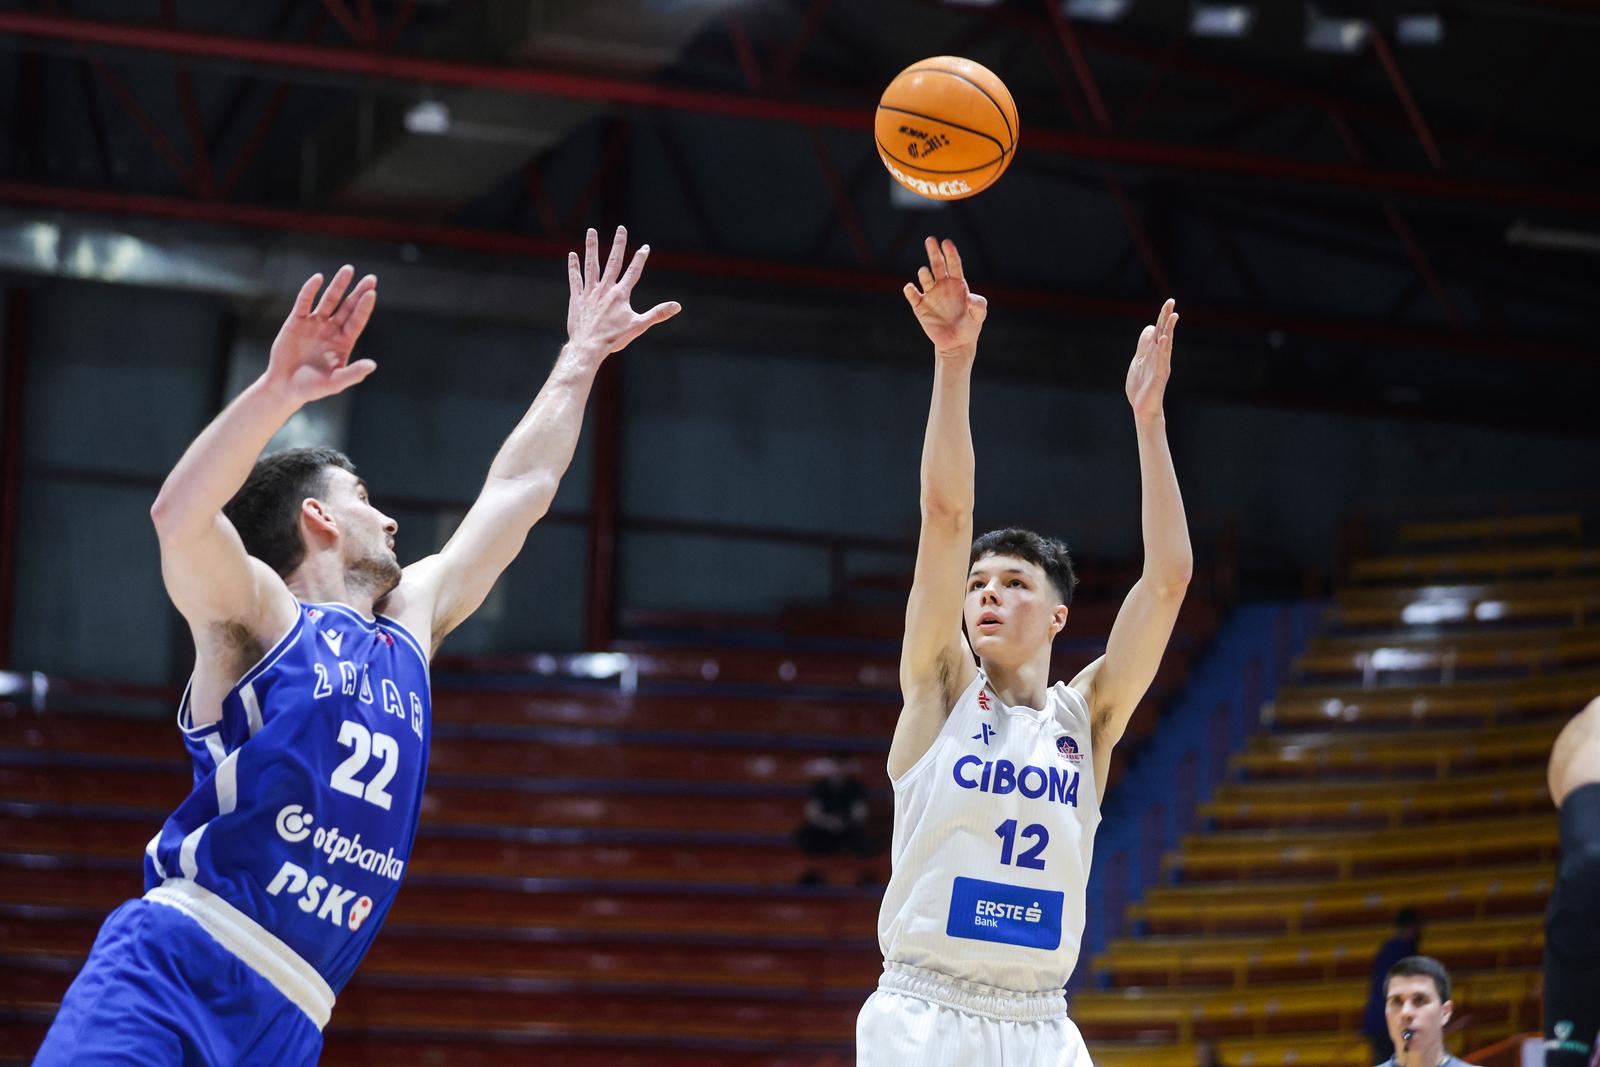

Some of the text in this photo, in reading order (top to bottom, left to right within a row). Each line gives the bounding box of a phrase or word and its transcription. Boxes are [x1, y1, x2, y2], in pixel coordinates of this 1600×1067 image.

[330, 720, 399, 810] 22
[953, 754, 1080, 808] CIBONA
[313, 827, 404, 880] otpbanka
[995, 818, 1049, 870] 12
[974, 916, 998, 927] Bank
[975, 899, 1024, 921] ERSTE
